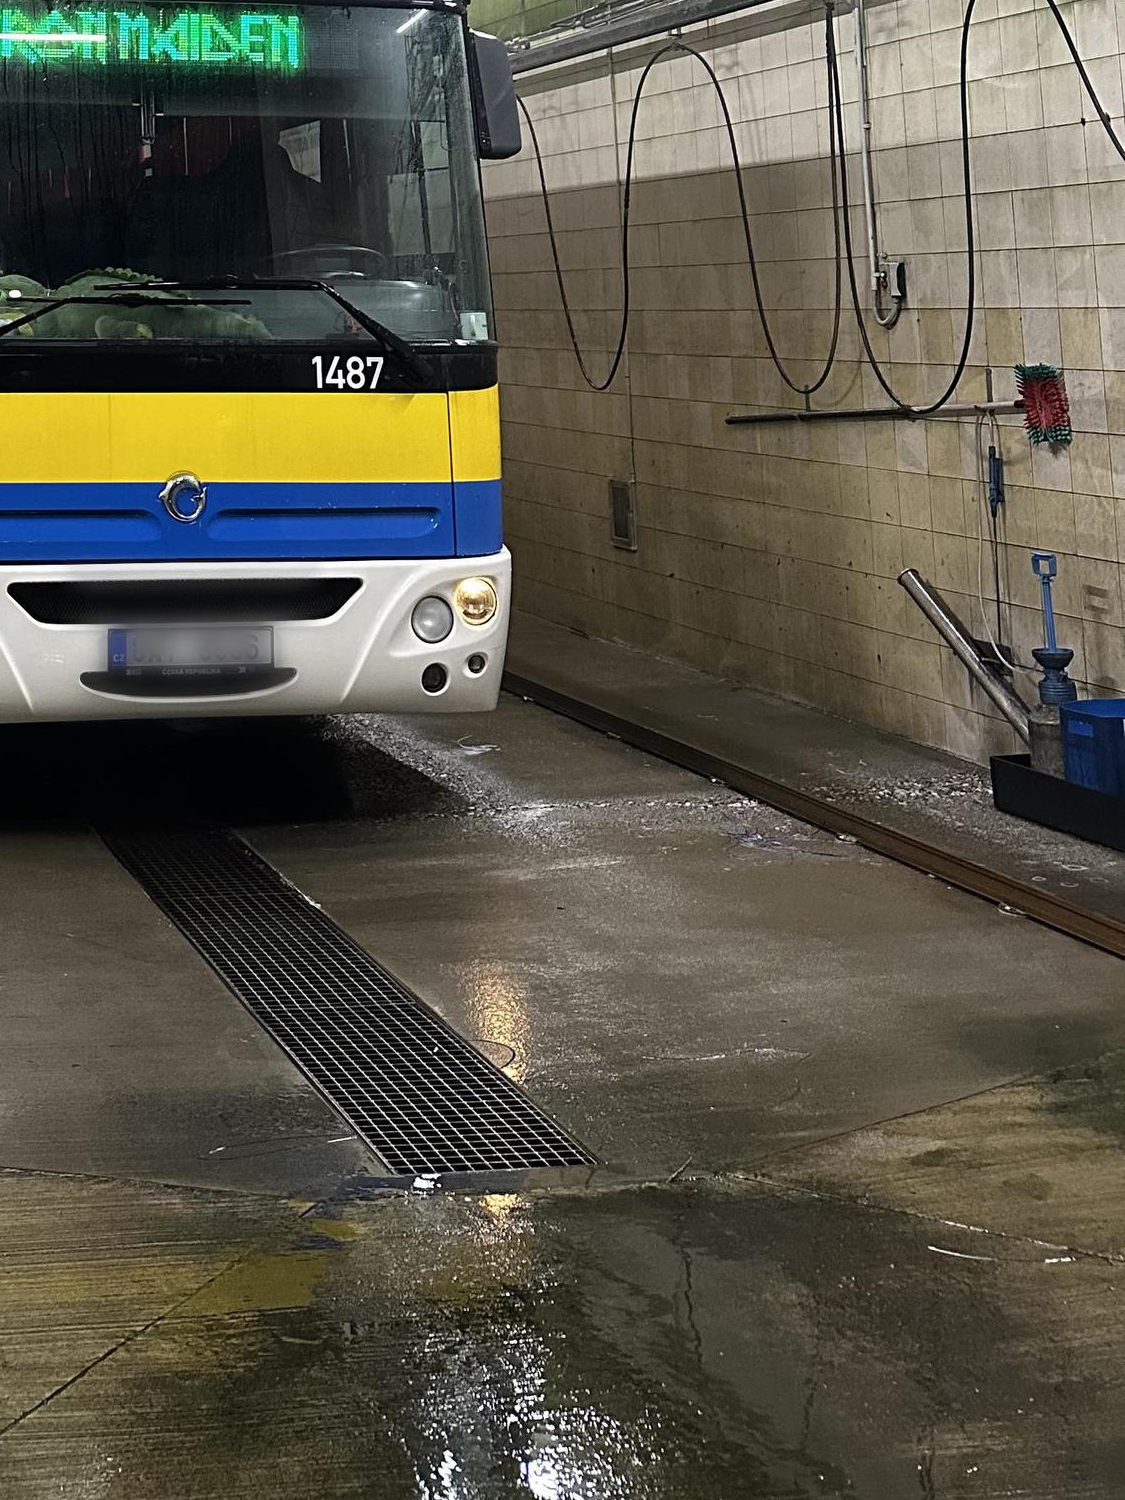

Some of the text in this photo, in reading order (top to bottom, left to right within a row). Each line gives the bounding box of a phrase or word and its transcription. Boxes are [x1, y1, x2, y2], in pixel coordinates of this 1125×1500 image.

[114, 9, 300, 68] MAIDEN
[312, 355, 384, 389] 1487
[113, 653, 125, 662] CZ
